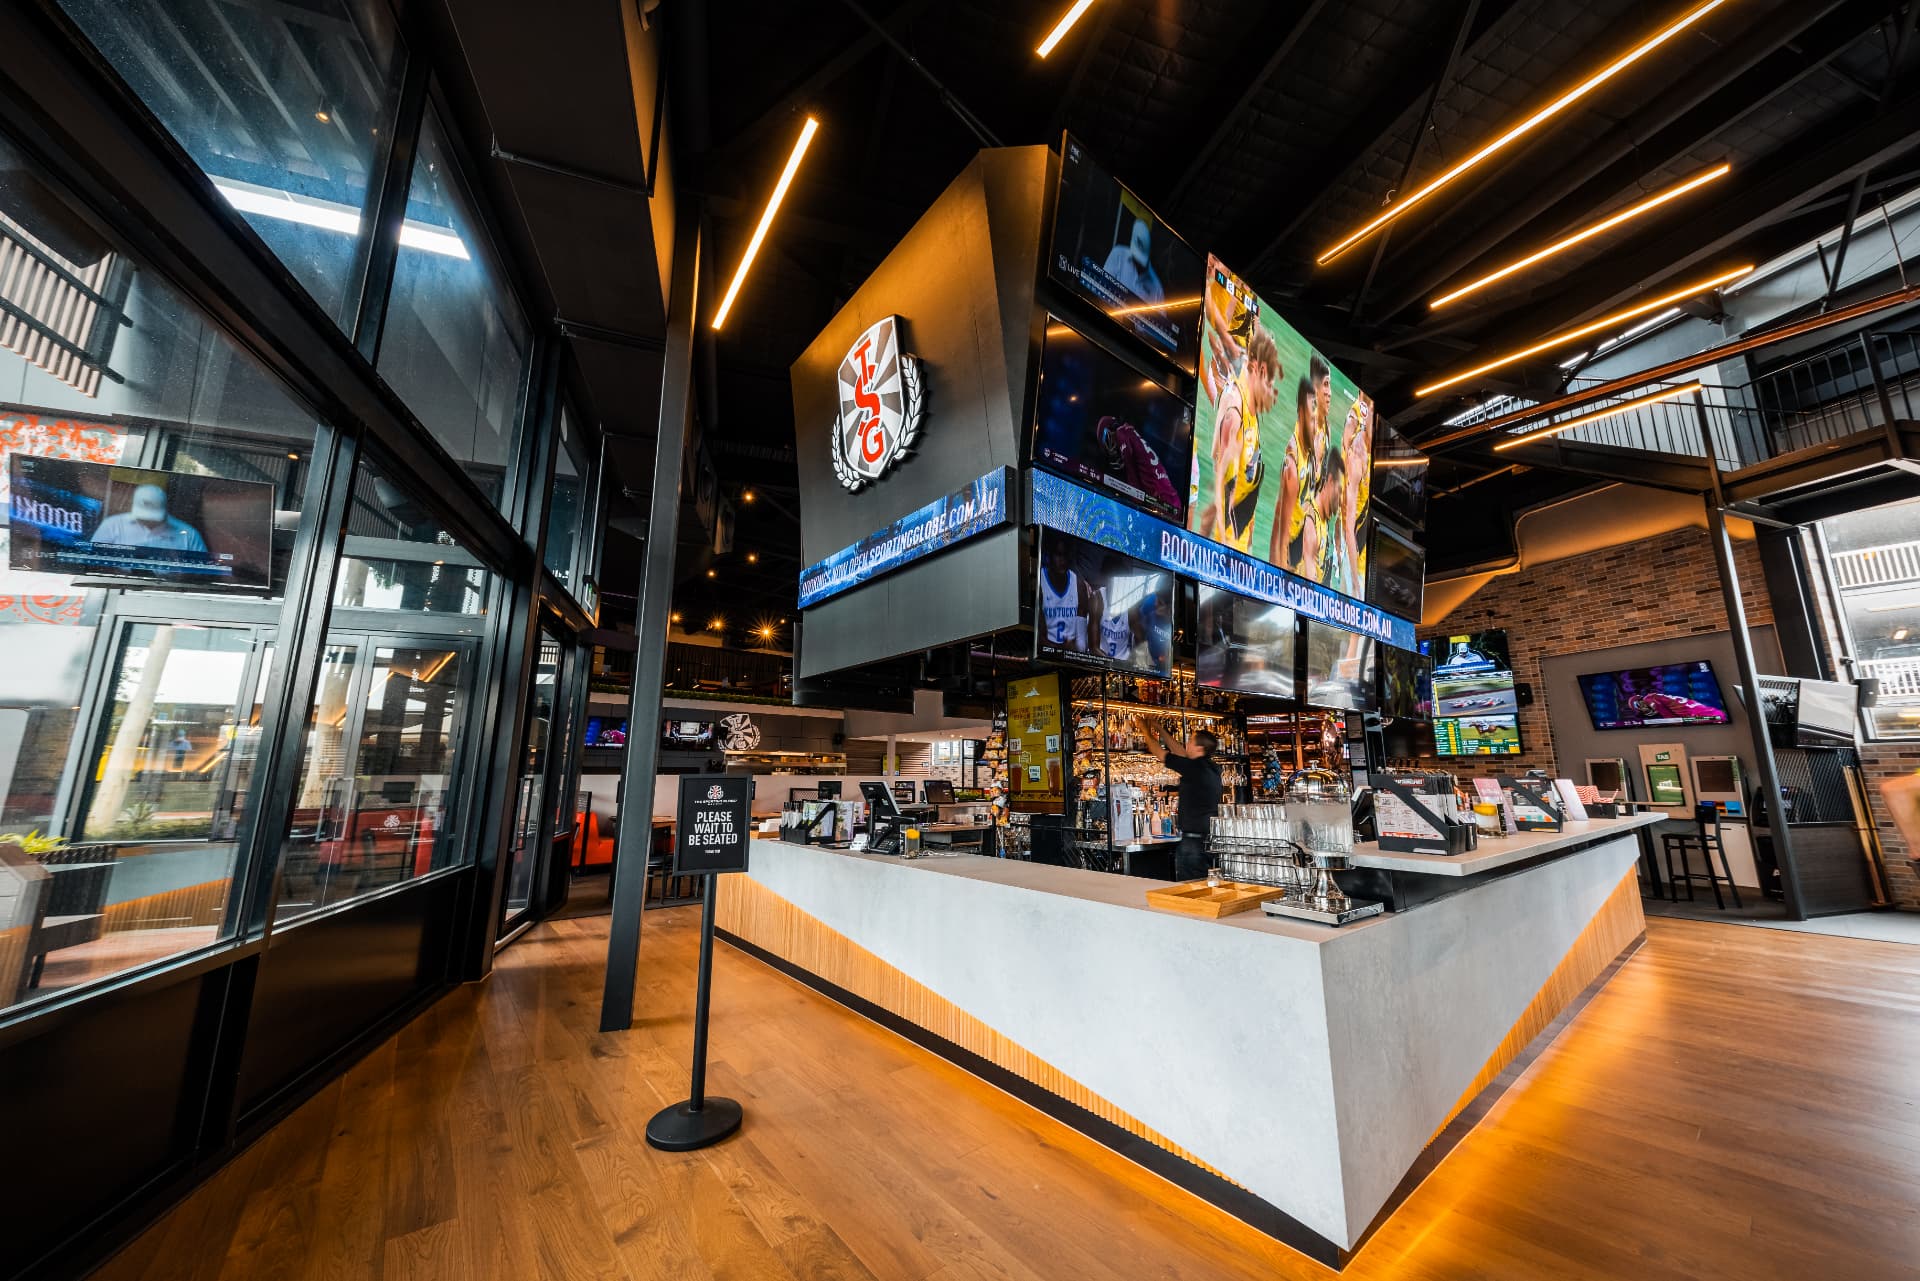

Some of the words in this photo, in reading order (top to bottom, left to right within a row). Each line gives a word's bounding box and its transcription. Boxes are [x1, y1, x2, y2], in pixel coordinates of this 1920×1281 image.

[1066, 262, 1080, 278] LIVE
[869, 487, 999, 562] SPORTINGGLOBE.COM.AU
[1161, 530, 1227, 580] BOOKINGS
[1229, 557, 1257, 591] NOW
[1259, 569, 1286, 600] OPEN
[1287, 581, 1393, 639] SPORTINGGLOBE.COM.AU
[1045, 606, 1078, 619] KENTUCKY
[1108, 642, 1117, 657] 3
[696, 811, 732, 823] PLEASE
[694, 822, 720, 834] WAIT
[721, 822, 733, 833] TO
[688, 834, 701, 846] BE
[702, 833, 738, 845] SEATED
